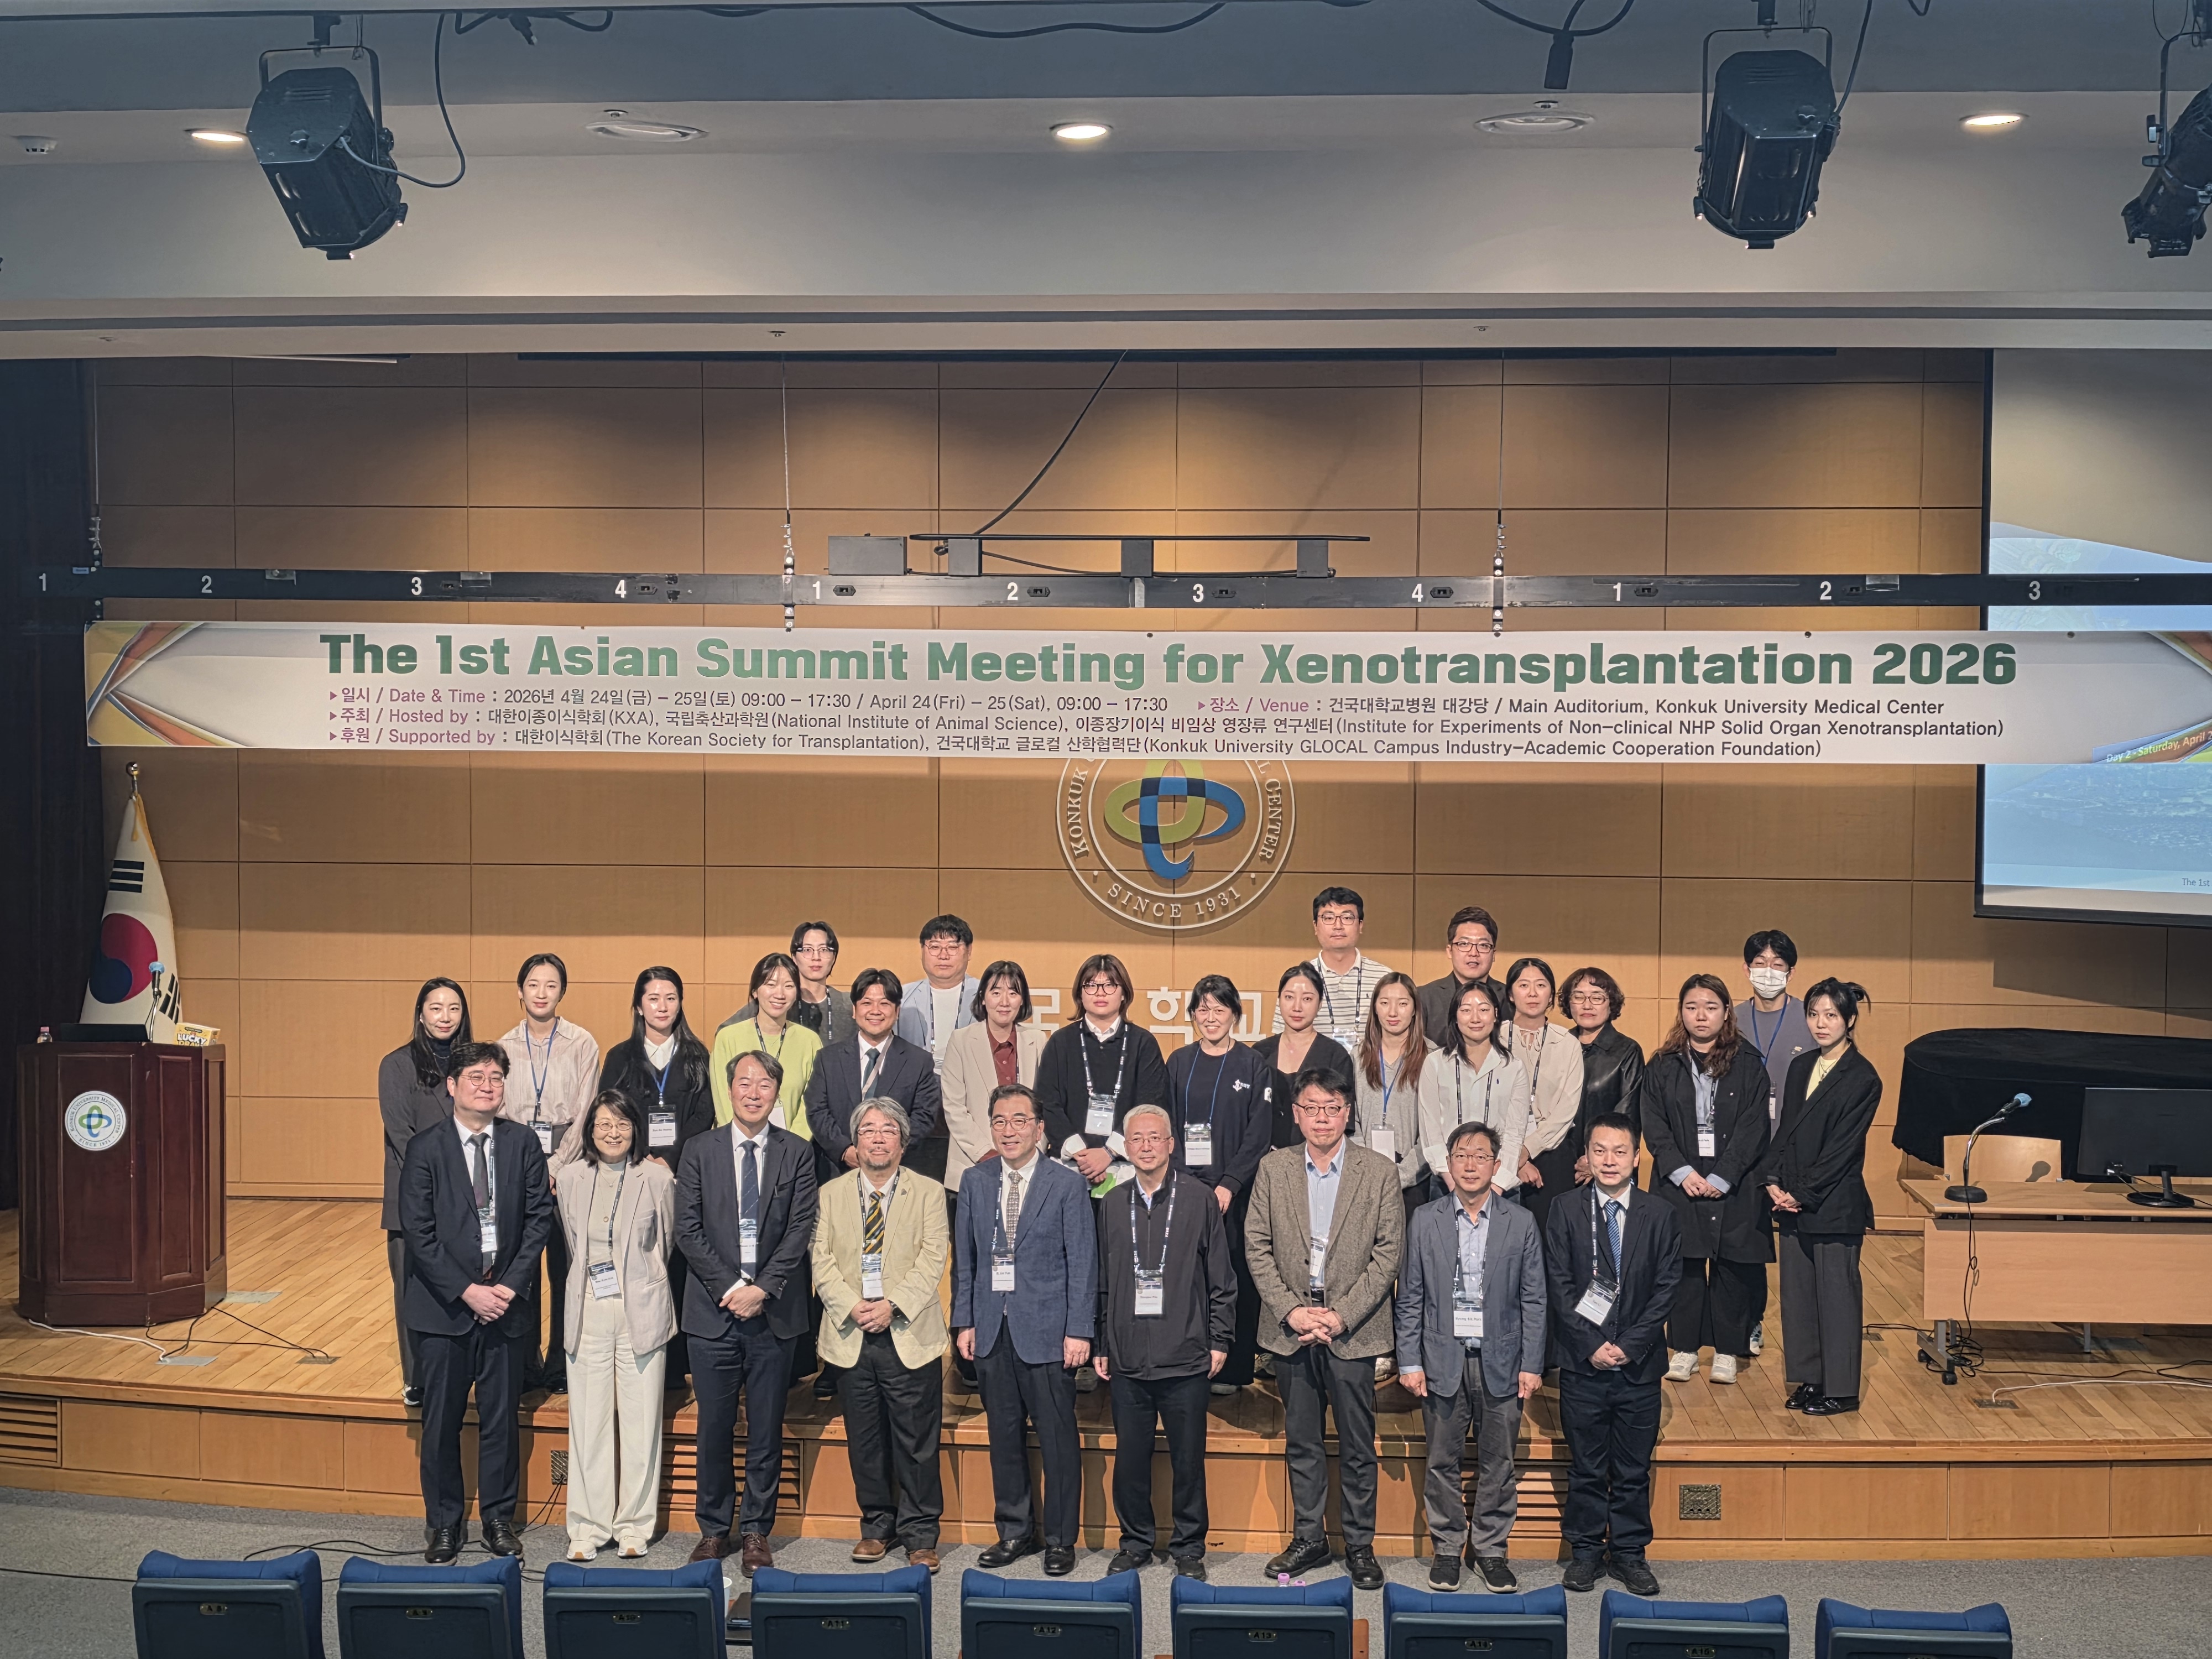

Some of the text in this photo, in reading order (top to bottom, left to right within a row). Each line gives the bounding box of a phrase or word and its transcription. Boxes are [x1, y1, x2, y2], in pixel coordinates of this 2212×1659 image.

[39, 573, 2041, 602] 1 2 3 4 1 2 3 4 1 2 3
[320, 634, 2017, 692] The 1st Asian Summit Meeting for Xenotransplantation 2026
[341, 687, 369, 703] 일시
[375, 687, 384, 703] /
[390, 688, 425, 702] Date
[431, 688, 442, 702] &
[448, 689, 486, 703] Time
[504, 688, 554, 704] 2026년
[560, 688, 585, 705] 4월
[741, 692, 785, 707] 09:00
[808, 693, 851, 708] 17:30
[856, 693, 864, 709] /
[869, 695, 906, 711] April
[1057, 696, 1102, 711] 09:00
[1124, 697, 1168, 712] 17:30
[1210, 697, 1240, 713] 장소
[1245, 697, 1253, 713] /
[1259, 698, 1309, 712] Venue
[1329, 697, 1436, 713] 건국대학교병원
[1443, 697, 1489, 714] 대강당
[1494, 697, 1503, 714] /
[1509, 698, 1548, 713] Main
[1553, 698, 1648, 715] Auditorium,
[1656, 699, 1718, 714] Konkuk
[1724, 699, 1808, 716] University
[1814, 699, 1880, 714] Medical
[1887, 699, 1944, 714] Center
[340, 707, 369, 723] 주최
[375, 707, 384, 724] /
[389, 708, 444, 723] Hosted
[450, 709, 468, 725] by
[848, 714, 909, 729] Institute
[915, 716, 930, 729] of
[935, 716, 988, 730] Animal
[994, 715, 1068, 733] Science),
[1076, 716, 1164, 733] 이종장기이식
[1171, 717, 1217, 733] 비임상
[1222, 717, 1267, 734] 영장류
[1412, 719, 1434, 733] for
[1441, 719, 1541, 735] Experiments
[1547, 719, 1563, 734] of
[1679, 720, 1715, 734] NHP
[1721, 719, 1763, 735] Solid
[1770, 719, 1821, 737] Organ
[1827, 719, 2004, 738] Xenotransplantation)
[340, 727, 369, 743] 후원
[375, 727, 383, 744] /
[389, 728, 471, 745] Supported
[477, 729, 495, 745] by
[648, 732, 702, 746] Korean
[708, 732, 766, 749] Society
[773, 734, 793, 748] for
[798, 734, 929, 752] Transplantation),
[937, 735, 1010, 752] 건국대학교
[1016, 736, 1060, 752] 글로컬
[1215, 739, 1293, 755] University
[1300, 739, 1368, 754] GLOCAL
[1374, 739, 1439, 756] Campus
[1612, 740, 1714, 758] Cooperation
[1721, 739, 1821, 758] Foundation)
[2106, 753, 2123, 763] Day
[2125, 750, 2131, 759] 2
[2183, 731, 2205, 747] April
[1067, 766, 1089, 858] KONKUK
[1259, 778, 1282, 859] CENTER
[2182, 878, 2196, 886] The
[1108, 883, 1240, 918] SINCE 1931
[178, 1033, 207, 1045] LUCKY
